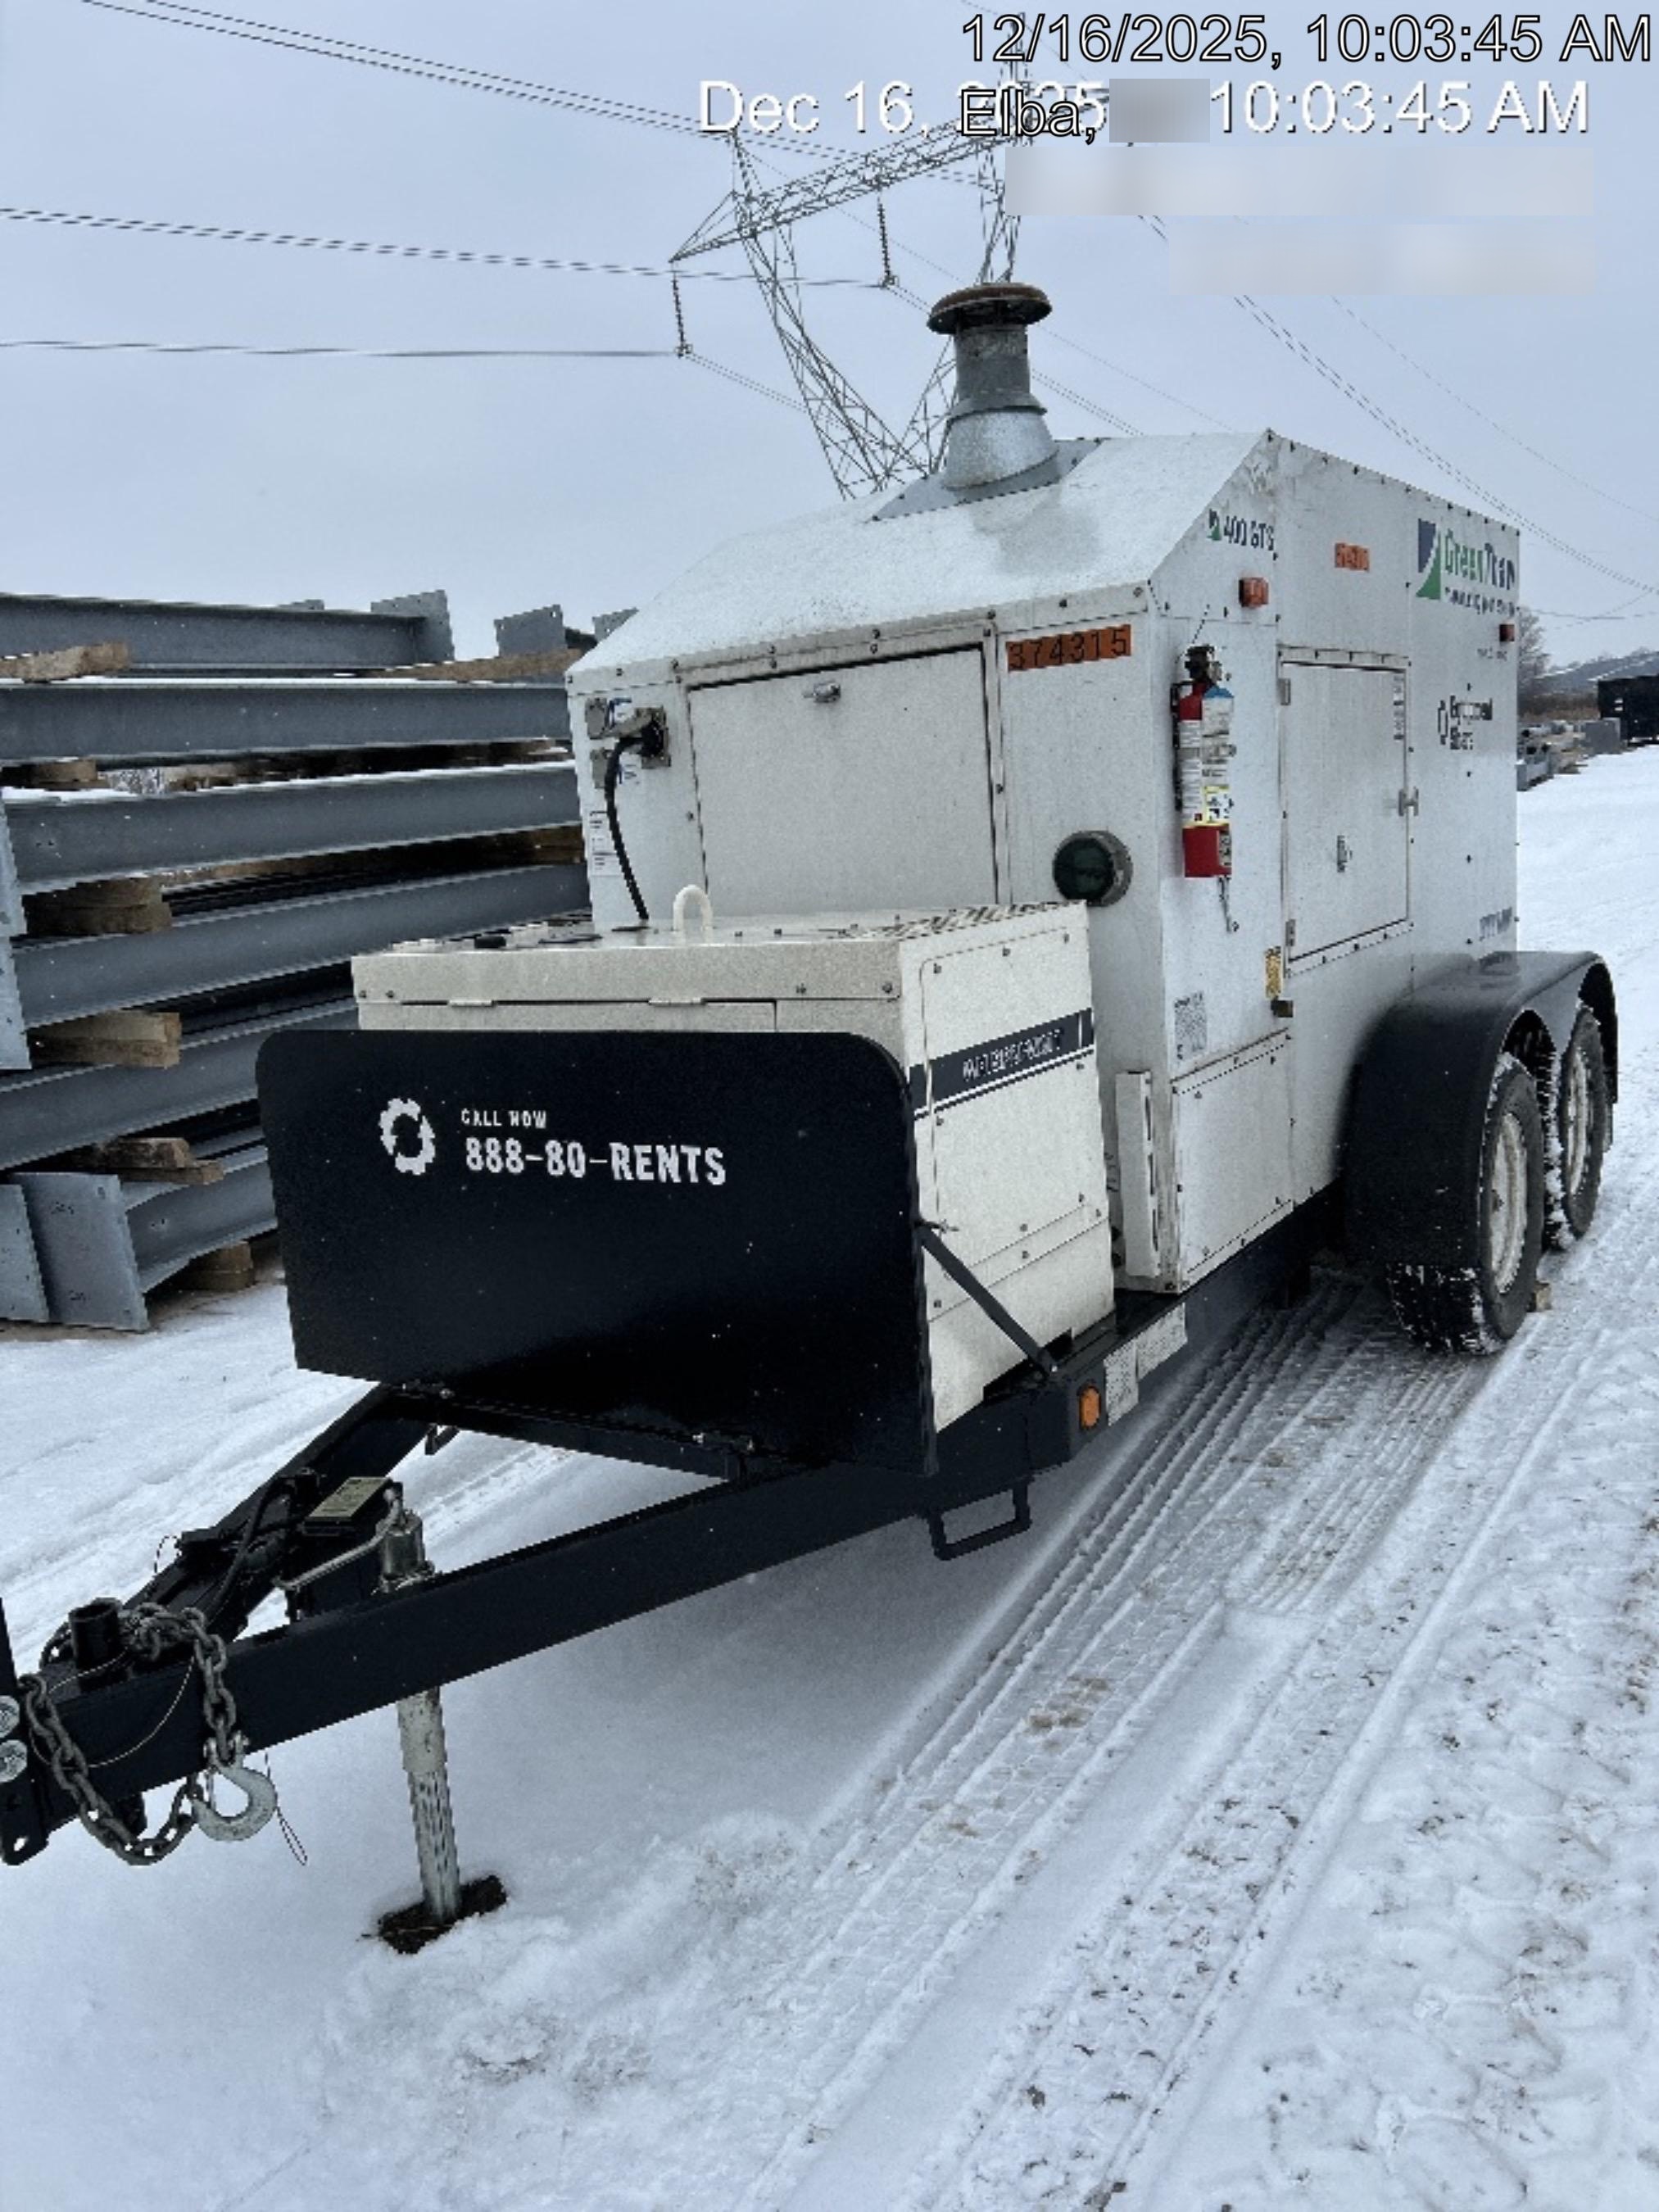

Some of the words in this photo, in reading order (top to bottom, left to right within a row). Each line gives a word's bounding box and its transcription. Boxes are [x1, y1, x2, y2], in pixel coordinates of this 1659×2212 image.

[1009, 625, 1127, 672] 374315
[461, 1108, 502, 1126] CALL
[508, 1110, 546, 1129] NOW
[466, 1137, 726, 1185] 888-80-RENTS
